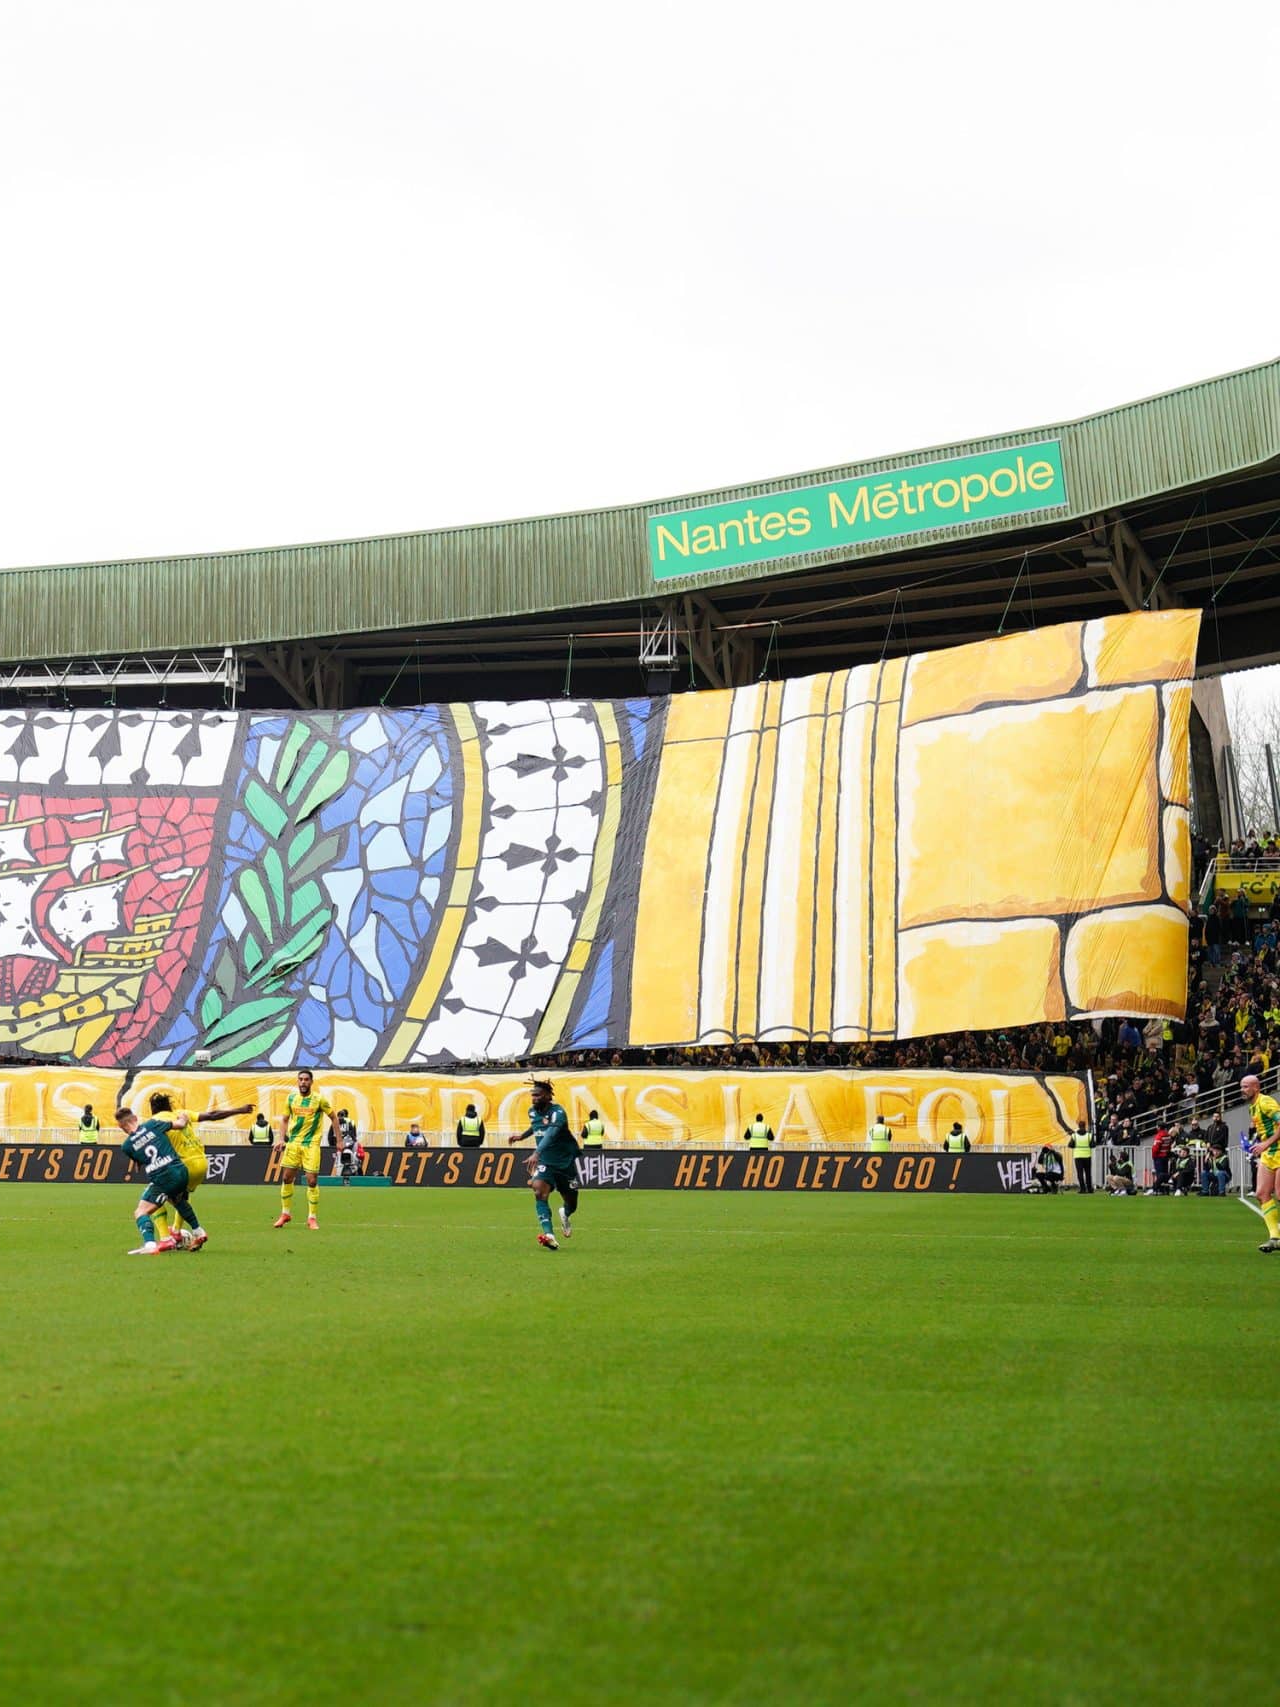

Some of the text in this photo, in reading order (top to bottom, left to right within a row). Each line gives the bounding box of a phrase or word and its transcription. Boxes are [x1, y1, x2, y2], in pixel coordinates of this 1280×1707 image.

[656, 507, 811, 561] Nantes
[863, 1086, 1011, 1152] FOI
[73, 1149, 113, 1181] GO
[474, 1153, 514, 1185] GO
[575, 1155, 643, 1188] HELLFEST
[674, 1155, 734, 1188] HEY
[742, 1156, 784, 1188] HO
[795, 1156, 882, 1190] LET'S
[893, 1157, 936, 1190] GO
